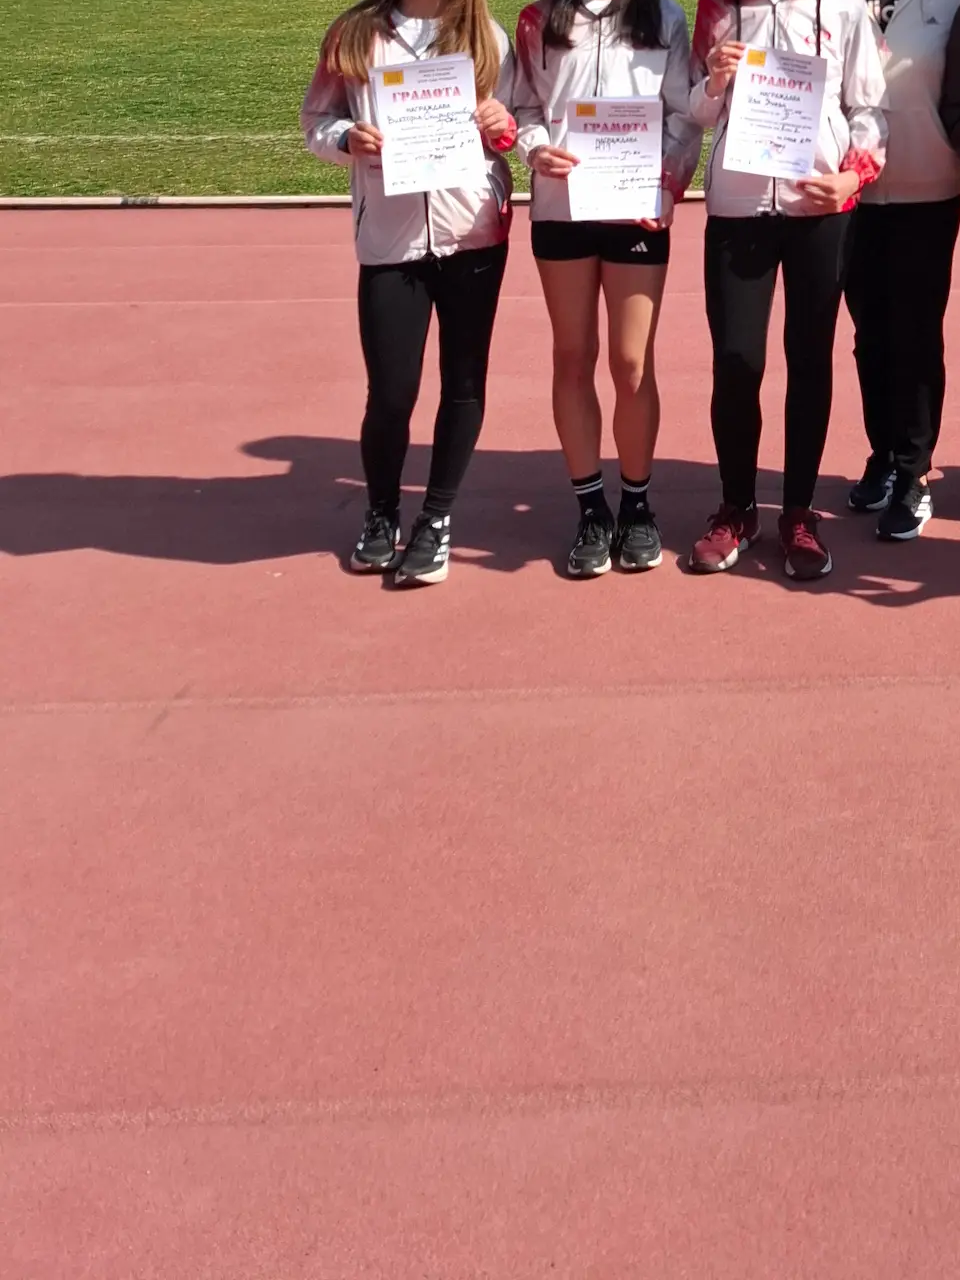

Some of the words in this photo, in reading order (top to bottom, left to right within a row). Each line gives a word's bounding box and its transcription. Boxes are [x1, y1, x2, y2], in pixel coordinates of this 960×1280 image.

[751, 73, 813, 93] ГРАМОТА
[392, 86, 462, 103] ГРАМОТА
[760, 91, 801, 102] НАГРАЖДАВА
[406, 104, 451, 114] НАГРАЖДАВА
[583, 122, 649, 133] ГРАМОТА
